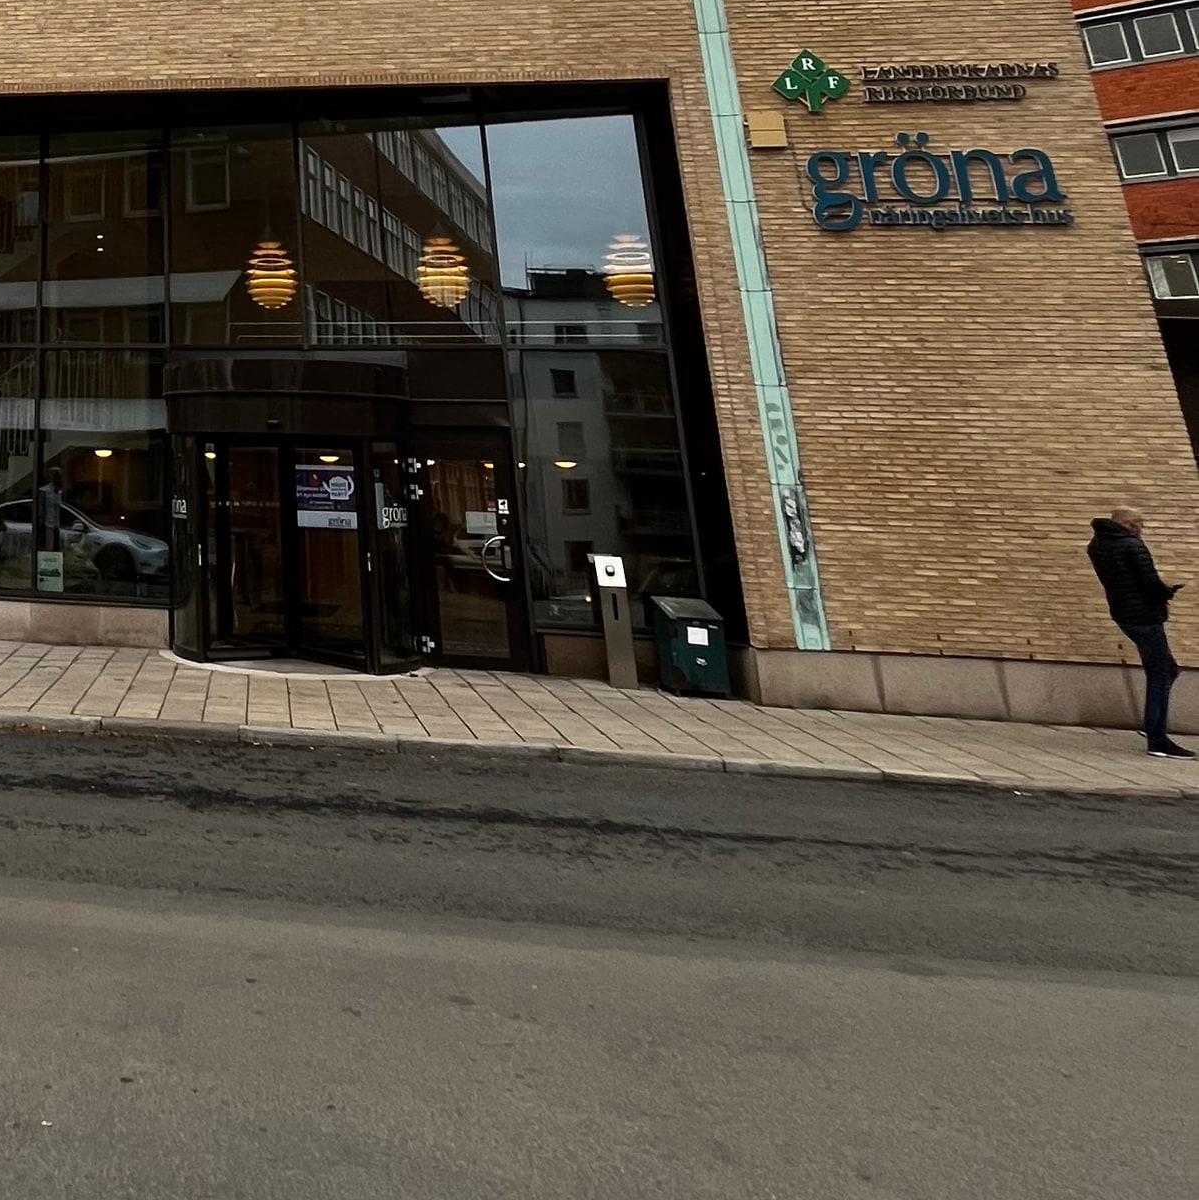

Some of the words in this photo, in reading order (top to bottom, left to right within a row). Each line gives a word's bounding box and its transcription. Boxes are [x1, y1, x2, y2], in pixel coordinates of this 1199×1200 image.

[801, 57, 816, 71] R
[861, 63, 1059, 81] LANTBRUKARNAS
[785, 77, 798, 90] L
[828, 76, 839, 89] F
[865, 83, 1027, 102] RIKSFÖRBUND
[806, 132, 1068, 231] gröna
[868, 205, 1023, 230] näringslivets
[1027, 204, 1074, 226] hus
